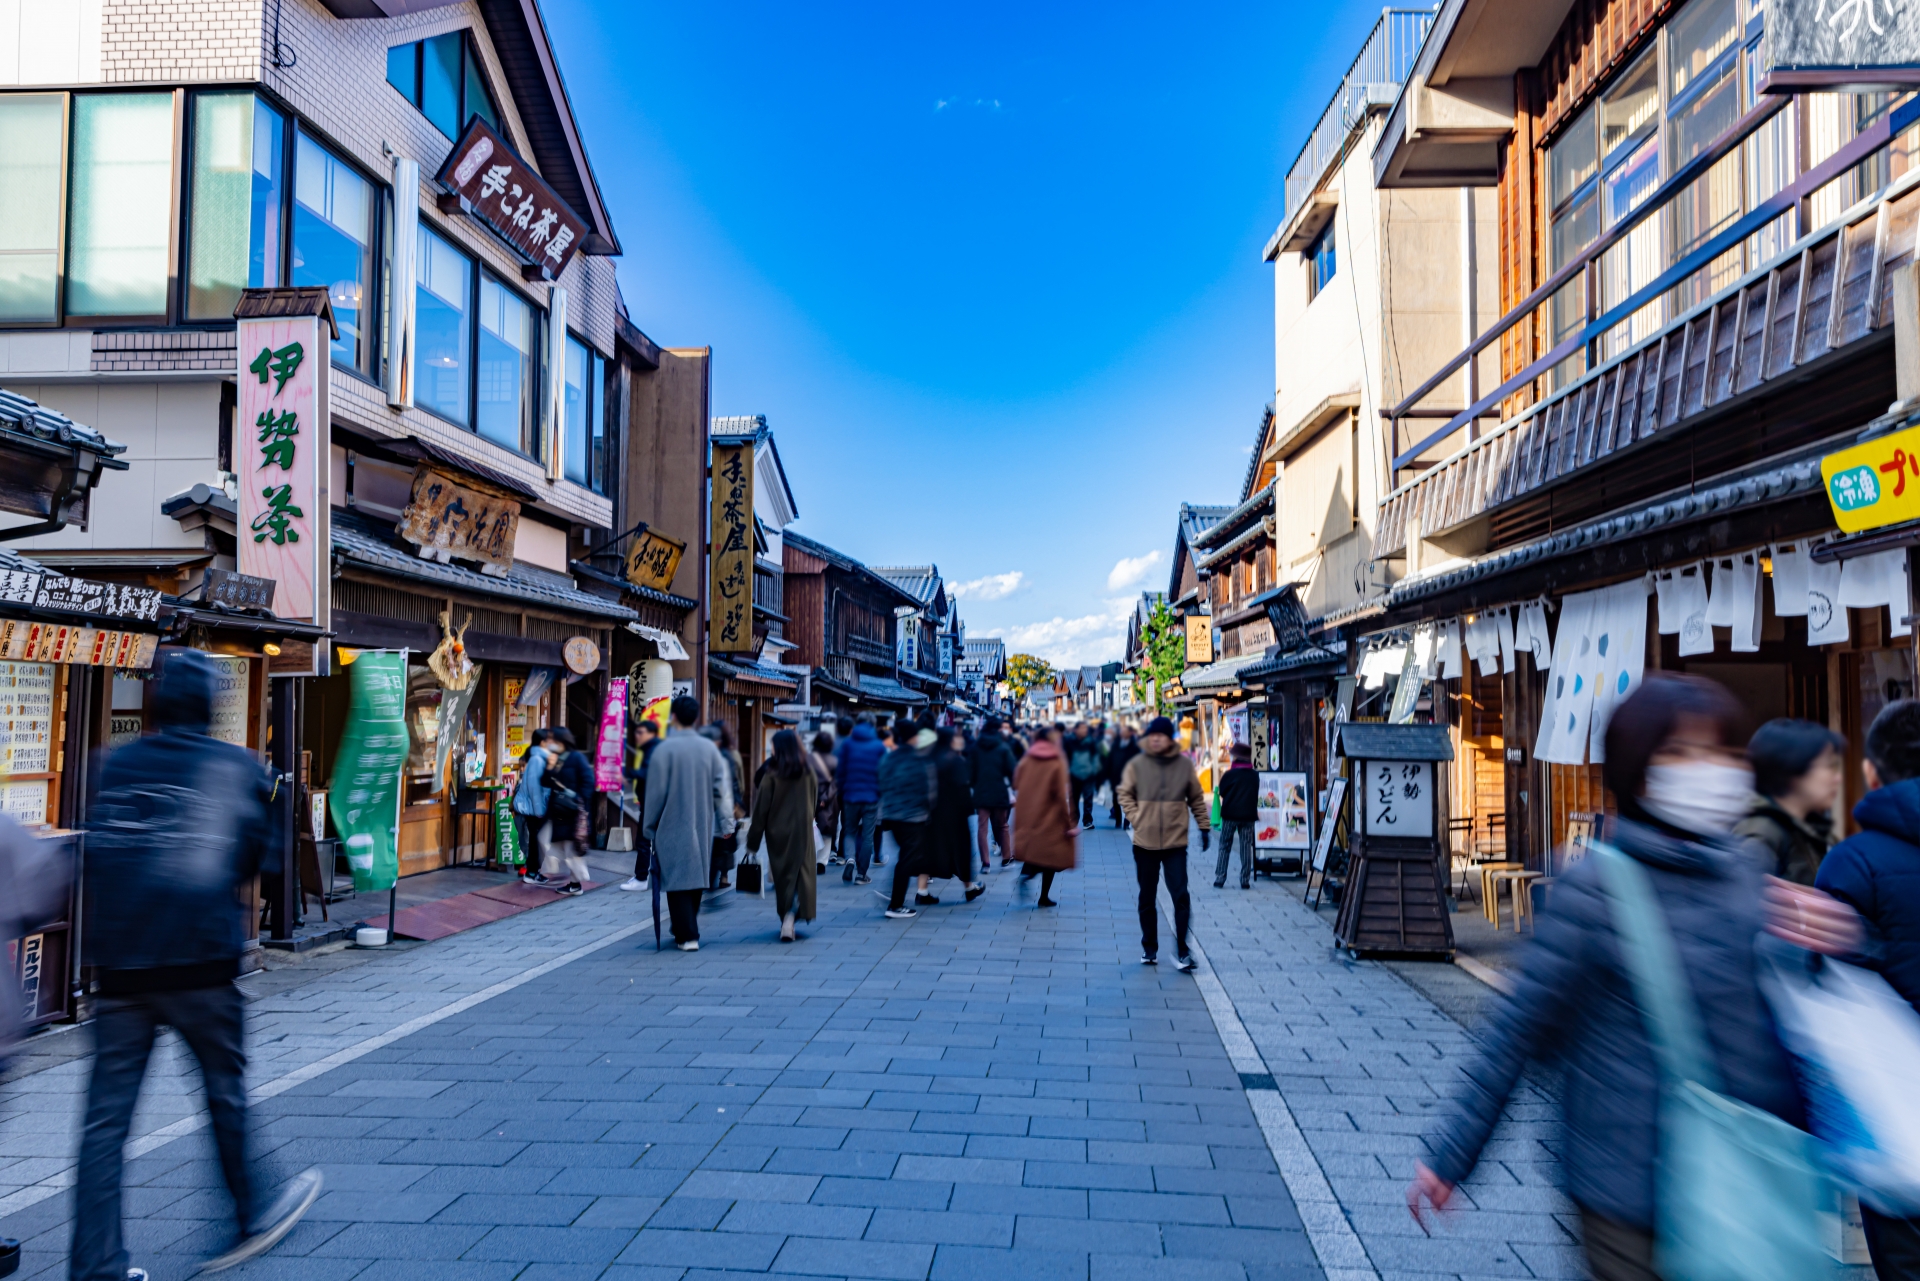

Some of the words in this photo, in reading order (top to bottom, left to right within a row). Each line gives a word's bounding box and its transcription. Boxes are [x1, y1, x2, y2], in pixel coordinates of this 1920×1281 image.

[480, 164, 575, 263] 手こね茶屋
[250, 341, 304, 545] 伊勢茶
[716, 452, 748, 567] 手こね茶屋
[106, 634, 117, 664] スポーツ
[1376, 767, 1397, 824] うどん
[1402, 764, 1421, 800] 伊勢
[21, 938, 41, 1018] ゴルフ用タグ
